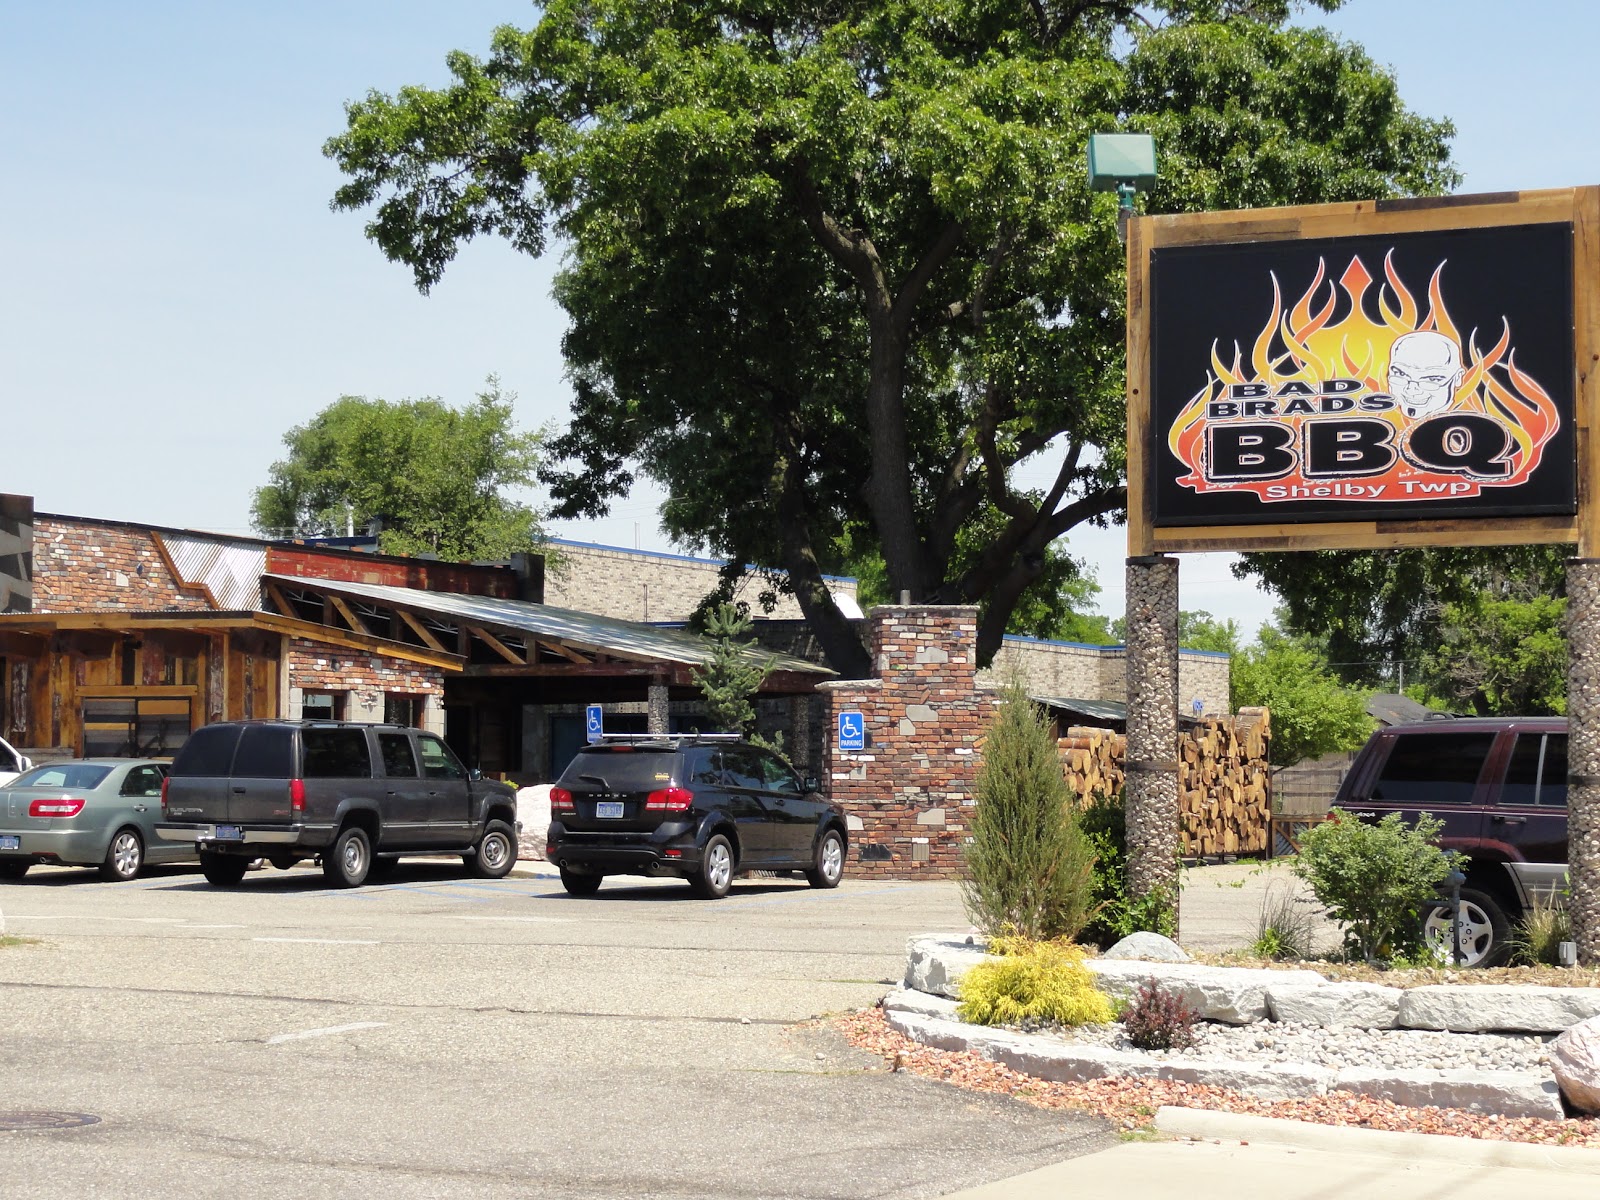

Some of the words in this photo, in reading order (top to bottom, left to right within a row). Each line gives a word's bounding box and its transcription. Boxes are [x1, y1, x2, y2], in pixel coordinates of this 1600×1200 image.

[1229, 379, 1365, 400] BAD
[1206, 394, 1398, 420] BRADS
[1203, 412, 1513, 482] BBQ
[1266, 483, 1387, 499] Shelby
[1398, 480, 1471, 496] Twp
